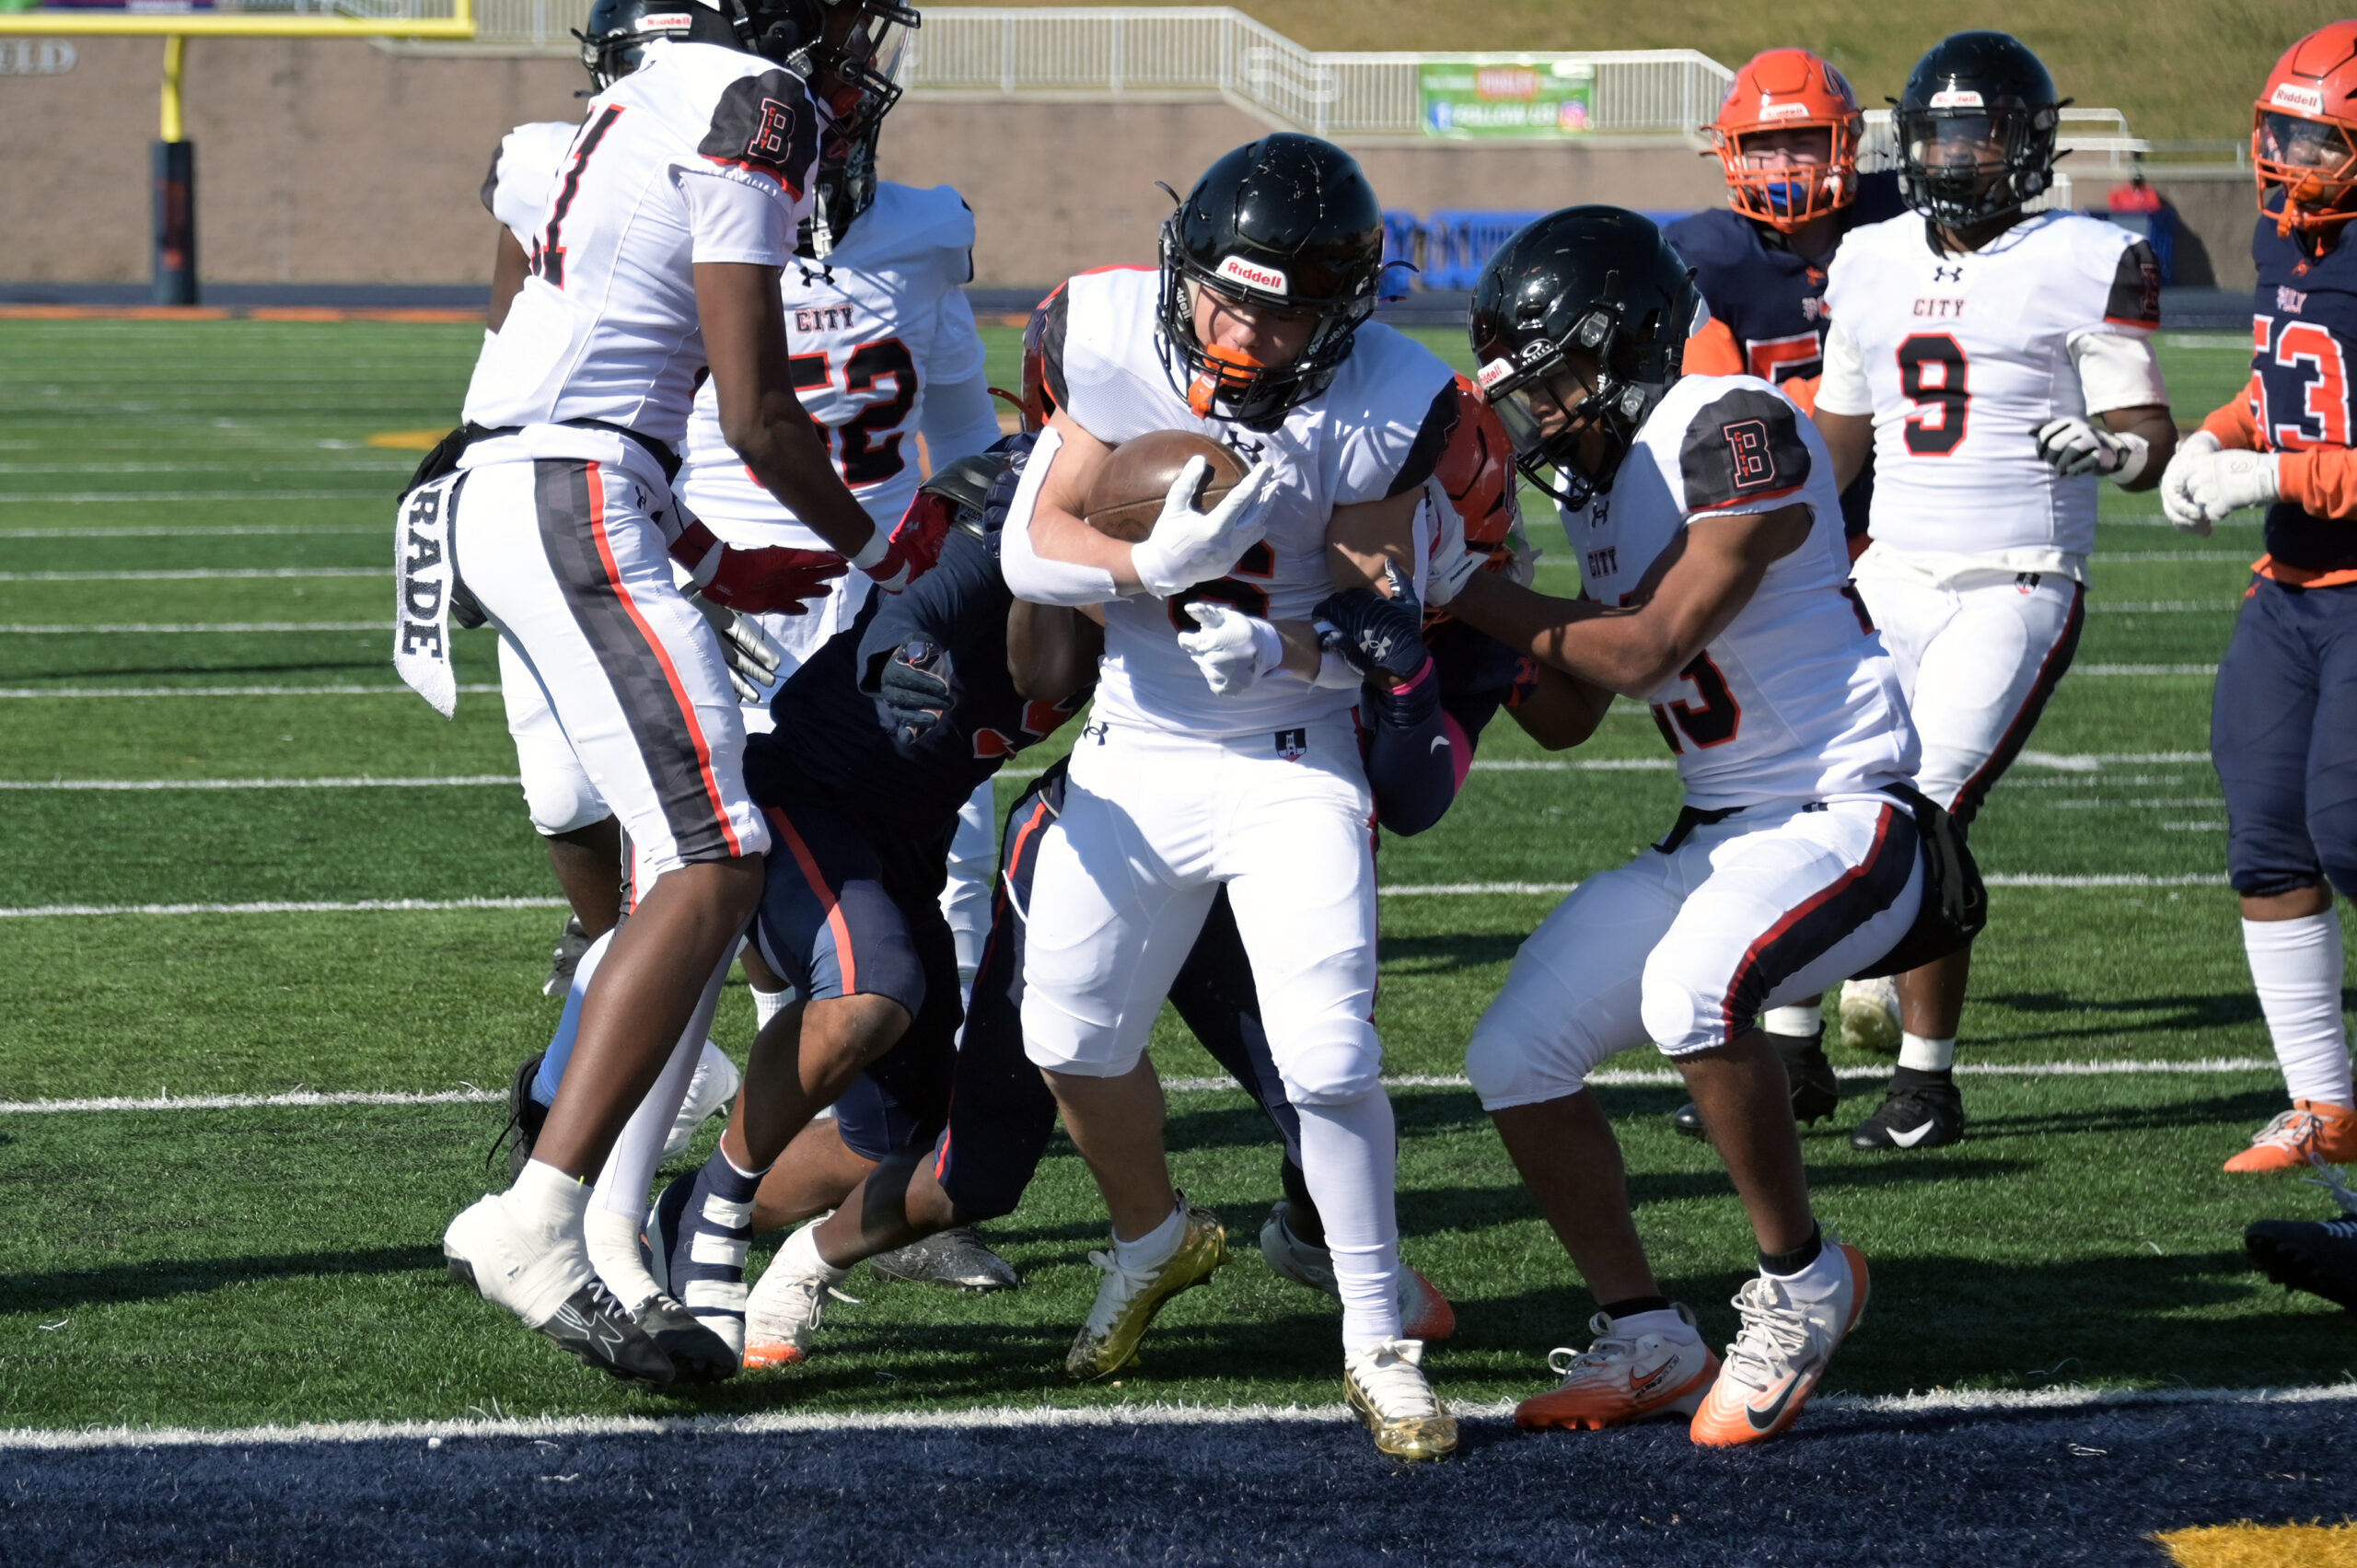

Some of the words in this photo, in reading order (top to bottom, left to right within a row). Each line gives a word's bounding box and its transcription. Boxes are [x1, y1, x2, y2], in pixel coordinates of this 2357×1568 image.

[2276, 88, 2318, 109] Riddell
[747, 97, 796, 164] B
[760, 106, 777, 149] CITY
[531, 103, 626, 291] 1
[1227, 261, 1283, 288] Riddell
[794, 304, 855, 334] CITY
[1912, 297, 1966, 318] CITY
[1895, 332, 1973, 457] 9
[1724, 419, 1776, 489] B
[1734, 431, 1749, 477] CITY
[401, 479, 444, 658] RADE
[1587, 545, 1620, 580] CITY
